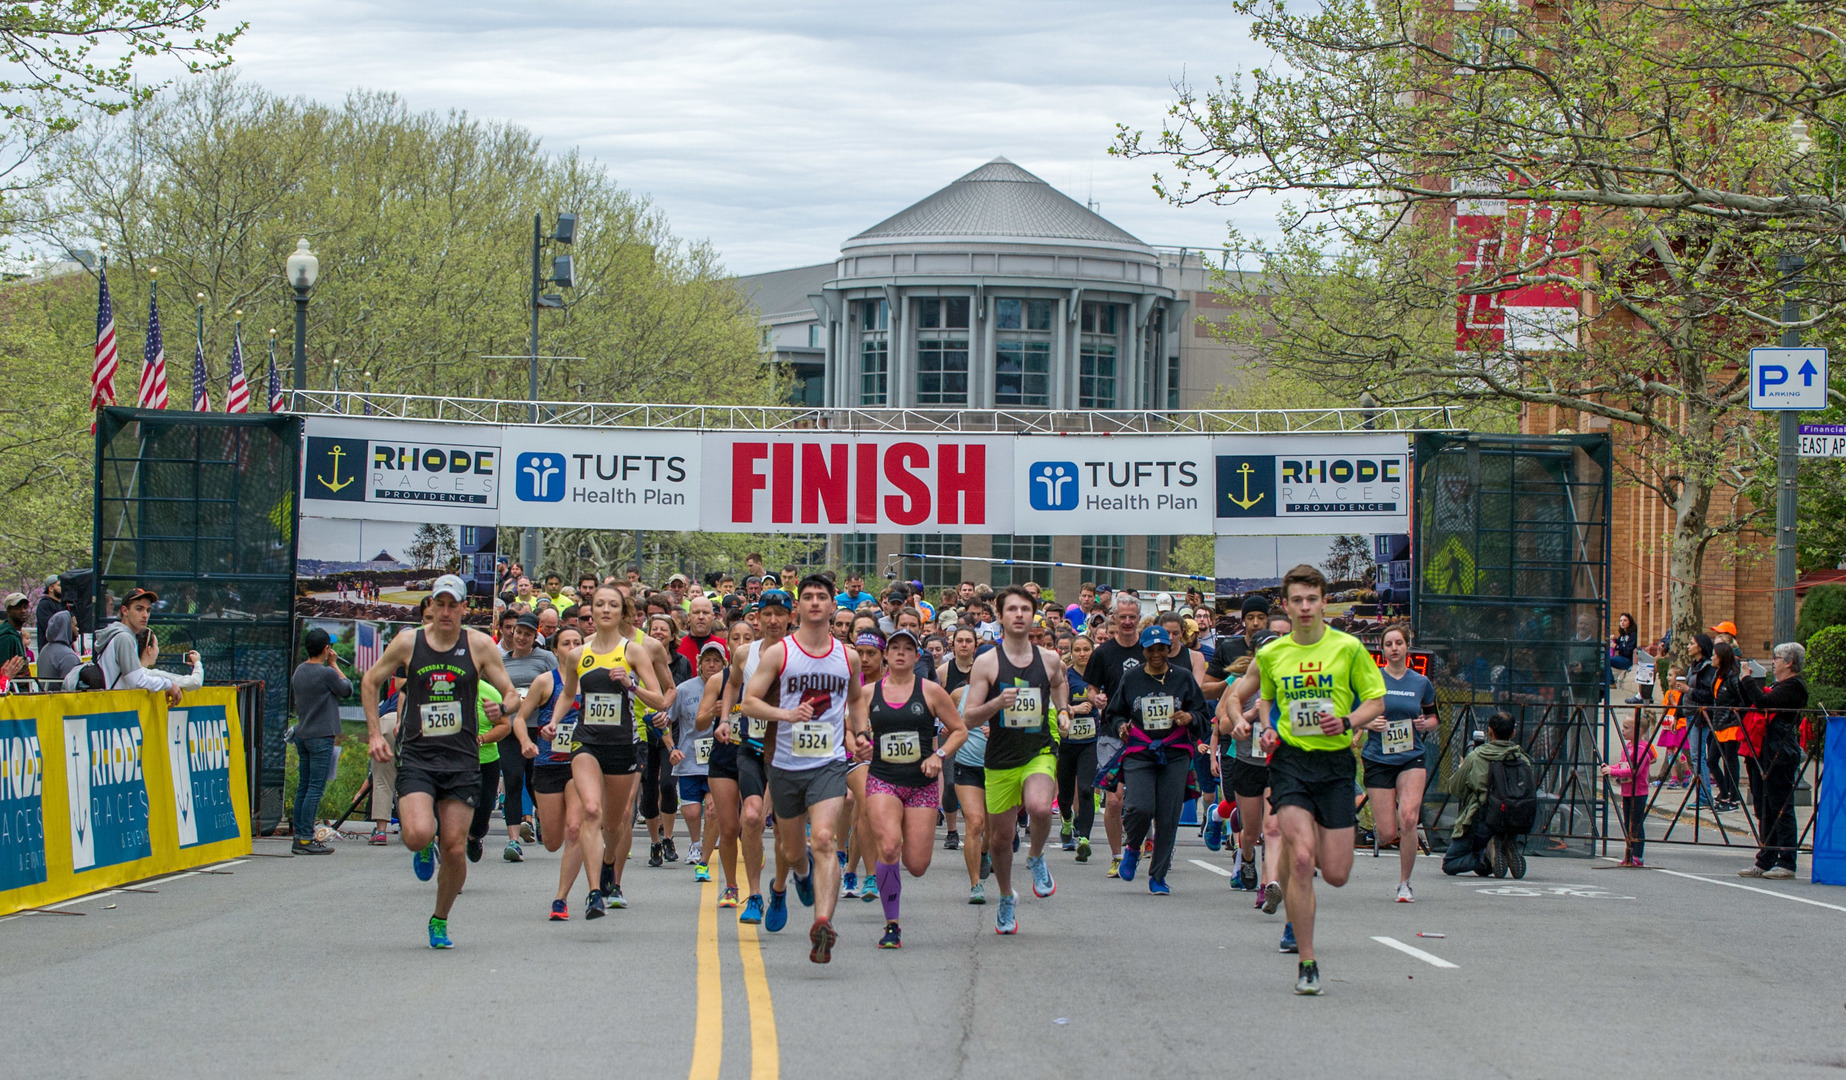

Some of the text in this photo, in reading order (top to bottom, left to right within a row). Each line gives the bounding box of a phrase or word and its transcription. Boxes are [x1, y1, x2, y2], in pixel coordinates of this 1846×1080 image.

[1803, 437, 1846, 454] EAST AP
[374, 446, 494, 475] RHODE
[572, 454, 686, 482] TUFTS
[1085, 461, 1198, 487] TUFTS
[1282, 460, 1400, 483] RHODE
[373, 473, 493, 492] RACES
[731, 442, 986, 525] FINISH
[384, 490, 475, 503] PROVIDENCE
[573, 487, 685, 505] Health Plan
[1282, 486, 1400, 500] RACES
[1086, 494, 1198, 510] Health Plan
[1294, 503, 1384, 511] PROVIDENCE
[416, 664, 445, 676] TUESDAY
[787, 672, 846, 698] BROWN
[1281, 674, 1333, 690] TEAM
[1285, 689, 1333, 700] PURSUIT
[590, 703, 615, 718] 5075
[1147, 705, 1169, 717] 5137
[1297, 710, 1327, 727] 516
[428, 712, 456, 729] 5268
[1073, 725, 1091, 735] 5257
[1387, 727, 1409, 741] 5104
[188, 719, 229, 772] RHODE
[558, 733, 570, 746] 52
[799, 734, 827, 749] 5324
[91, 727, 142, 787] RHODE
[887, 742, 914, 756] 5302
[0, 736, 42, 799] HODE
[93, 789, 149, 827] RACES
[2, 806, 43, 844] ACES
